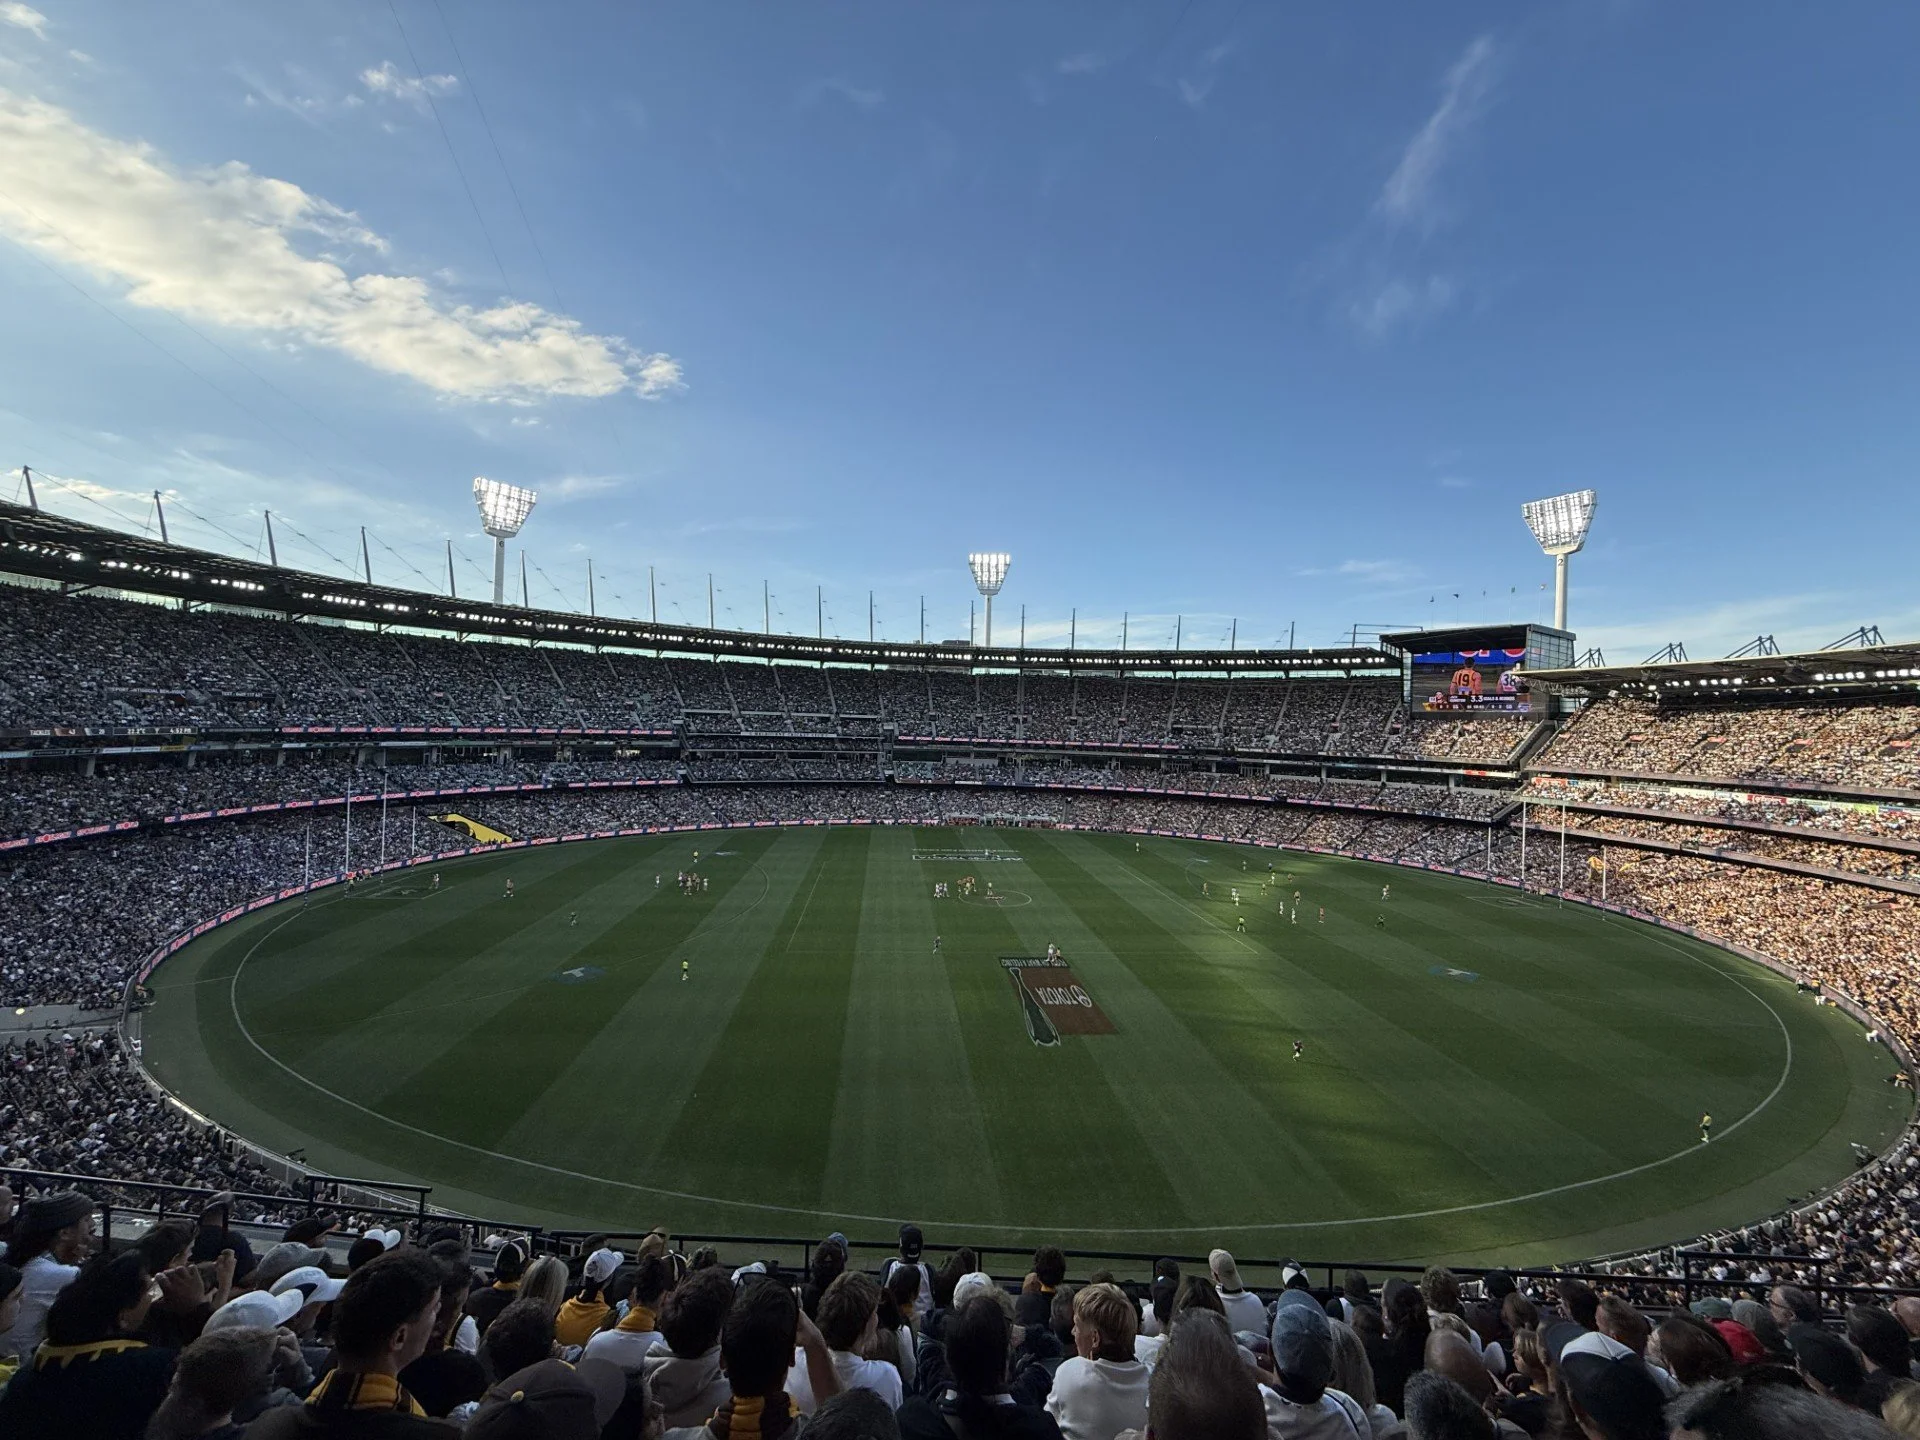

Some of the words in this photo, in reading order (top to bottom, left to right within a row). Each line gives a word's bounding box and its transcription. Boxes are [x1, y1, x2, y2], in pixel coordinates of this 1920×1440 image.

[1458, 674, 1469, 686] 19
[1470, 695, 1484, 703] 3.3
[1035, 986, 1079, 1005] TOYOTA
